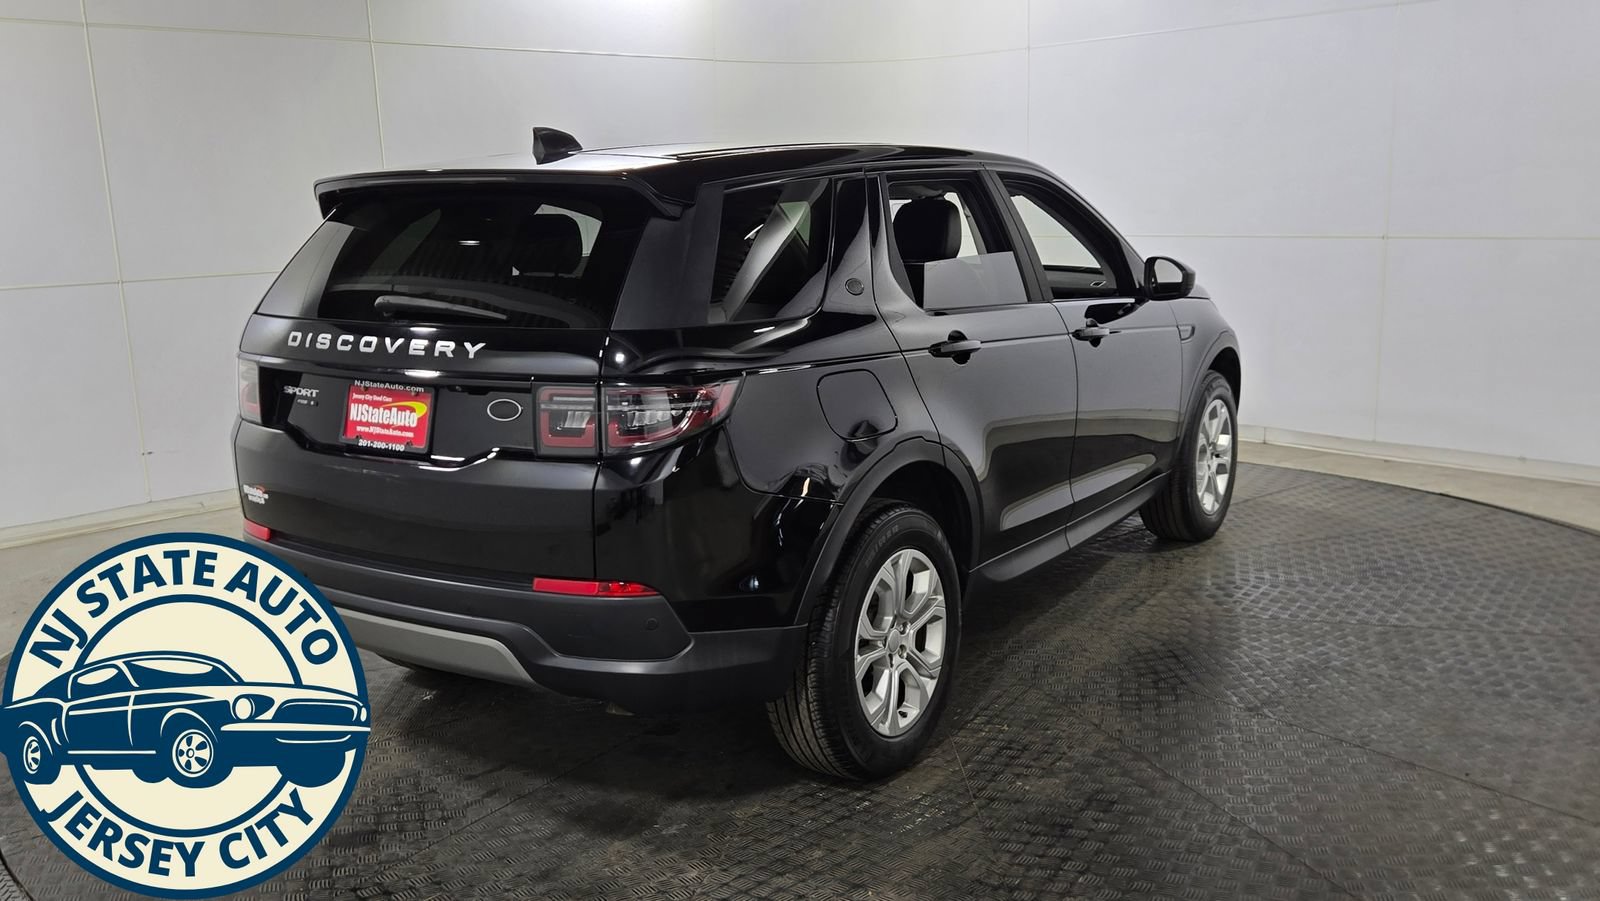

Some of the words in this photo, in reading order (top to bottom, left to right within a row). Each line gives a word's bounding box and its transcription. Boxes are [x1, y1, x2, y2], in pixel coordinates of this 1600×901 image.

[287, 331, 486, 359] DISCOVERY
[283, 386, 319, 397] SPORT
[354, 380, 424, 392] NJStateAuto.com
[350, 403, 418, 427] NJStateAuto
[358, 439, 405, 452] 201-200-1100
